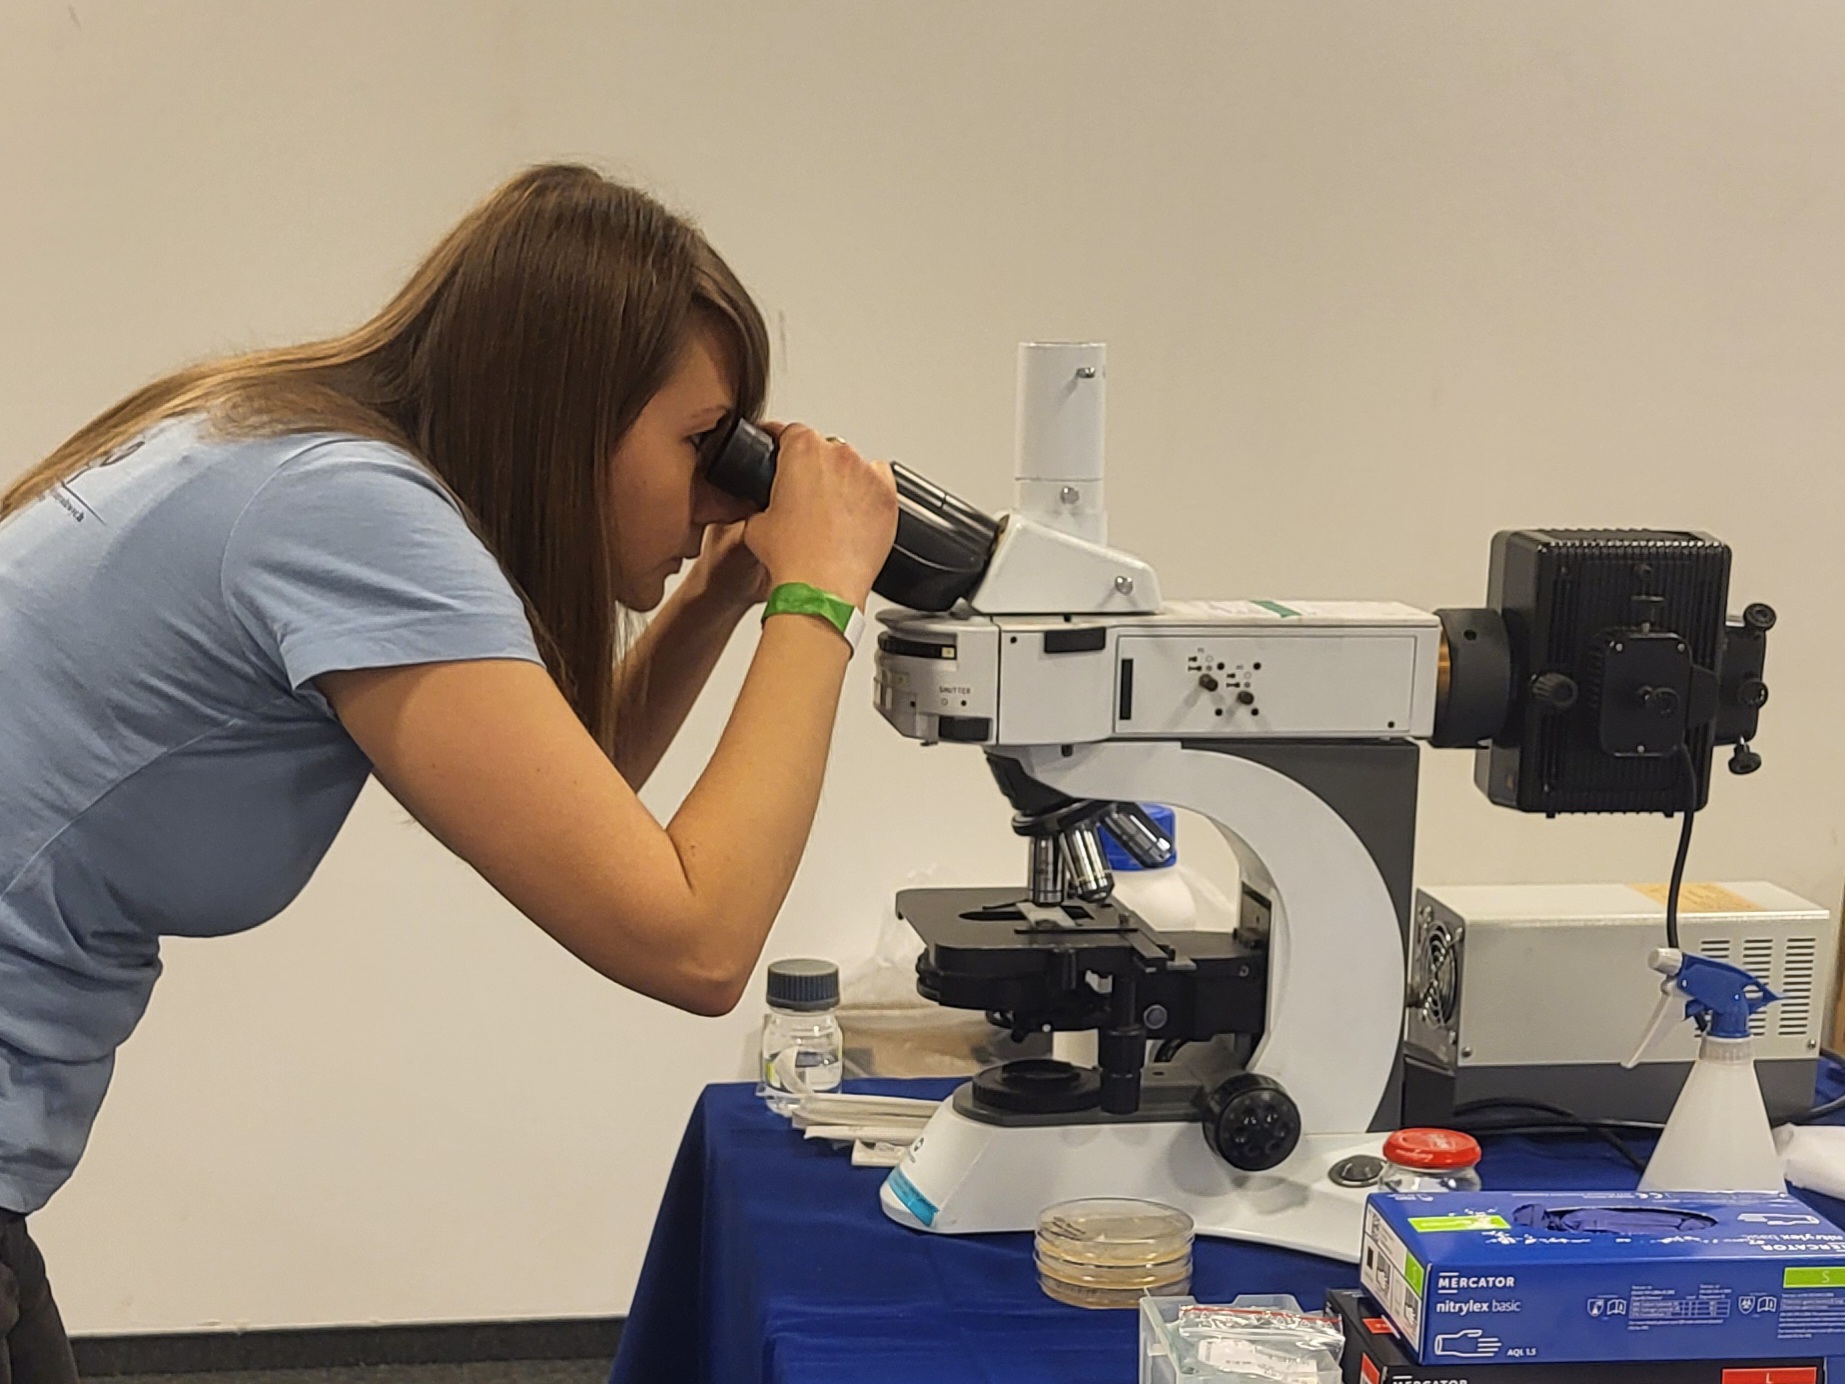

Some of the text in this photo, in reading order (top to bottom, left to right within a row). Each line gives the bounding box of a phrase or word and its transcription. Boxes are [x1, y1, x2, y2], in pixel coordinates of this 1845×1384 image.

[1437, 1276, 1515, 1289] MERCATOR
[1436, 1300, 1521, 1315] nitrylex basic
[1507, 1348, 1536, 1357] AQL 1.5
[1765, 1372, 1772, 1384] L
